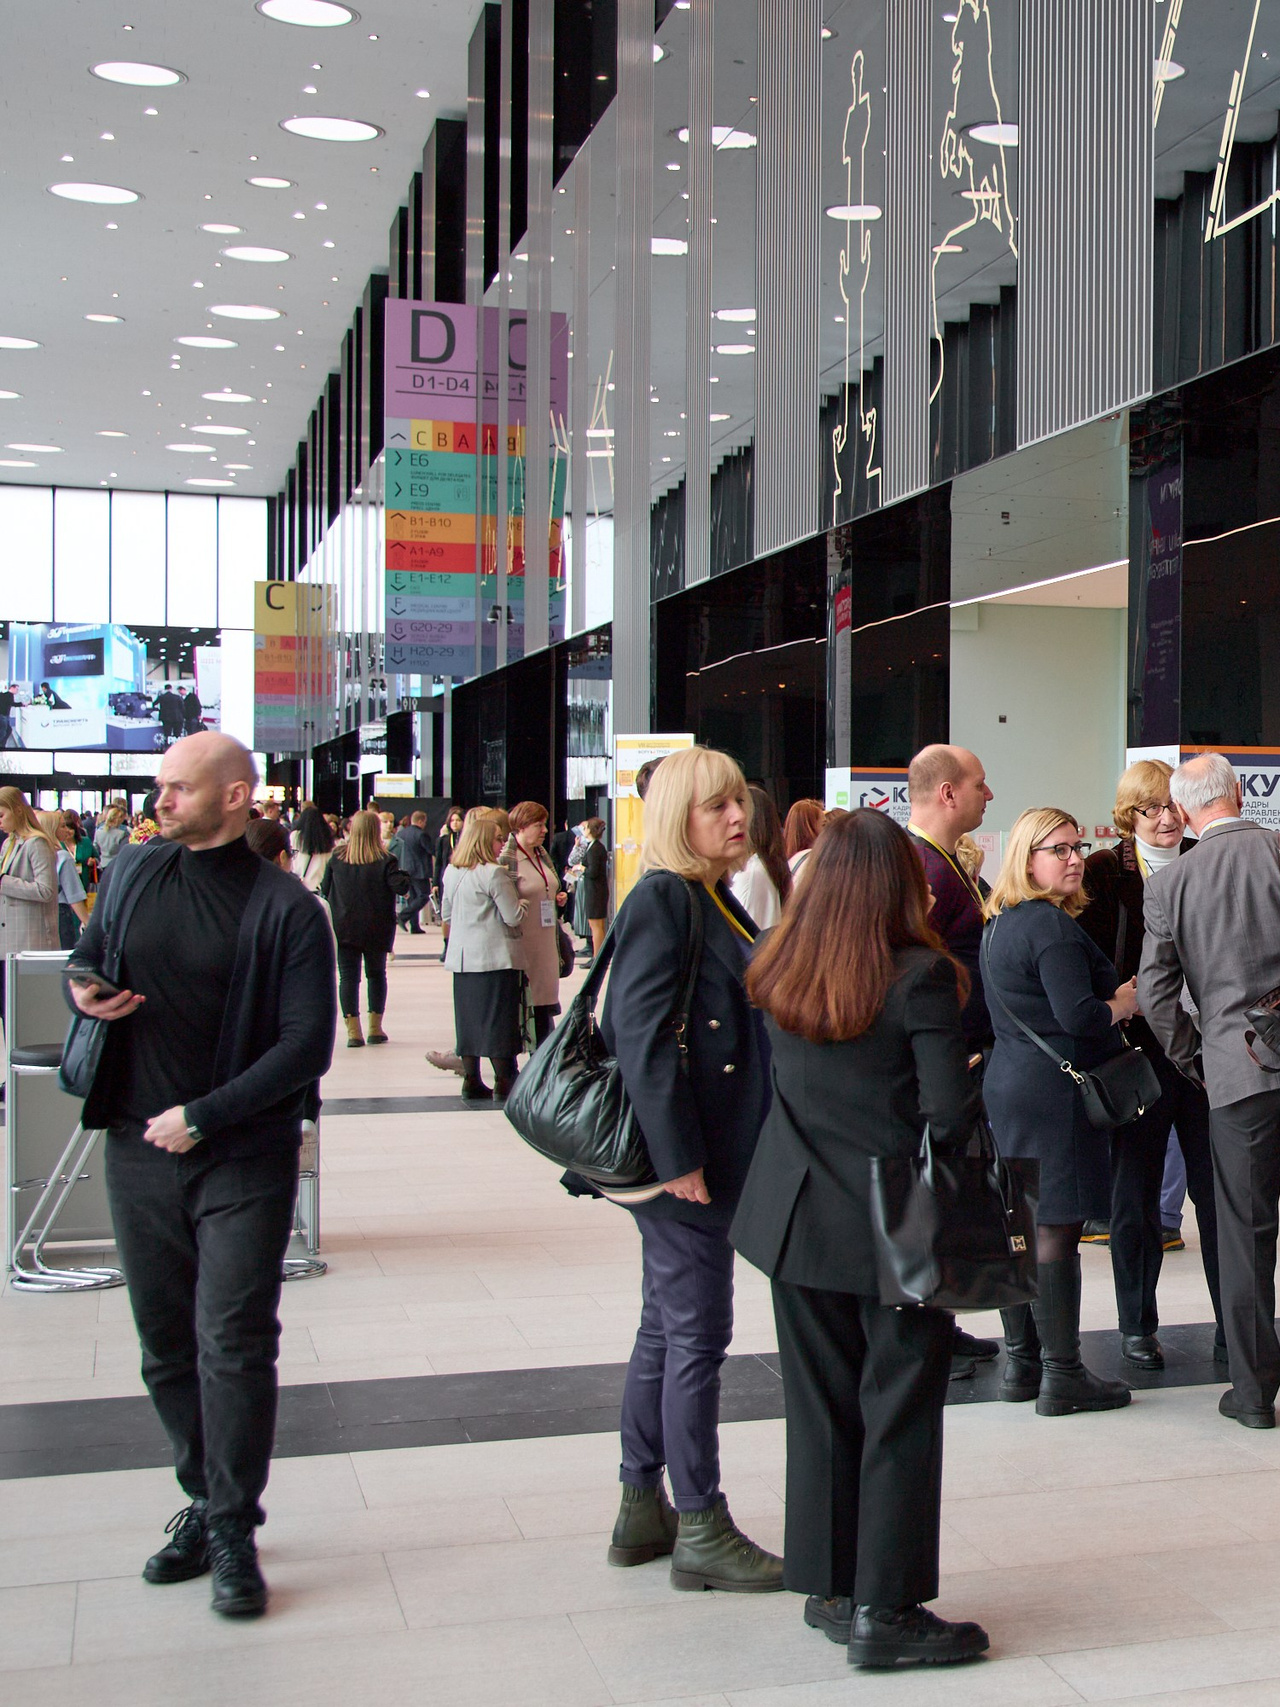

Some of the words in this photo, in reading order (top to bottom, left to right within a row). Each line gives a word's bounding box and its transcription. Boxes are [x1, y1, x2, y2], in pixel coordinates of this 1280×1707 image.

[410, 309, 456, 364] D
[412, 374, 470, 392] D1-D4
[417, 431, 426, 445] C
[437, 432, 447, 447] B
[458, 434, 469, 448] A
[410, 453, 429, 467] E6
[410, 483, 429, 497] E9
[410, 517, 451, 527] B1-B10
[410, 547, 444, 557] A1-A9
[395, 573, 401, 584] E
[410, 574, 452, 584] E1-E12
[265, 583, 285, 610] C
[395, 597, 401, 608] F
[395, 623, 403, 634] G
[410, 623, 452, 632] G20-29
[393, 647, 403, 658] H
[410, 647, 454, 656] H20-29
